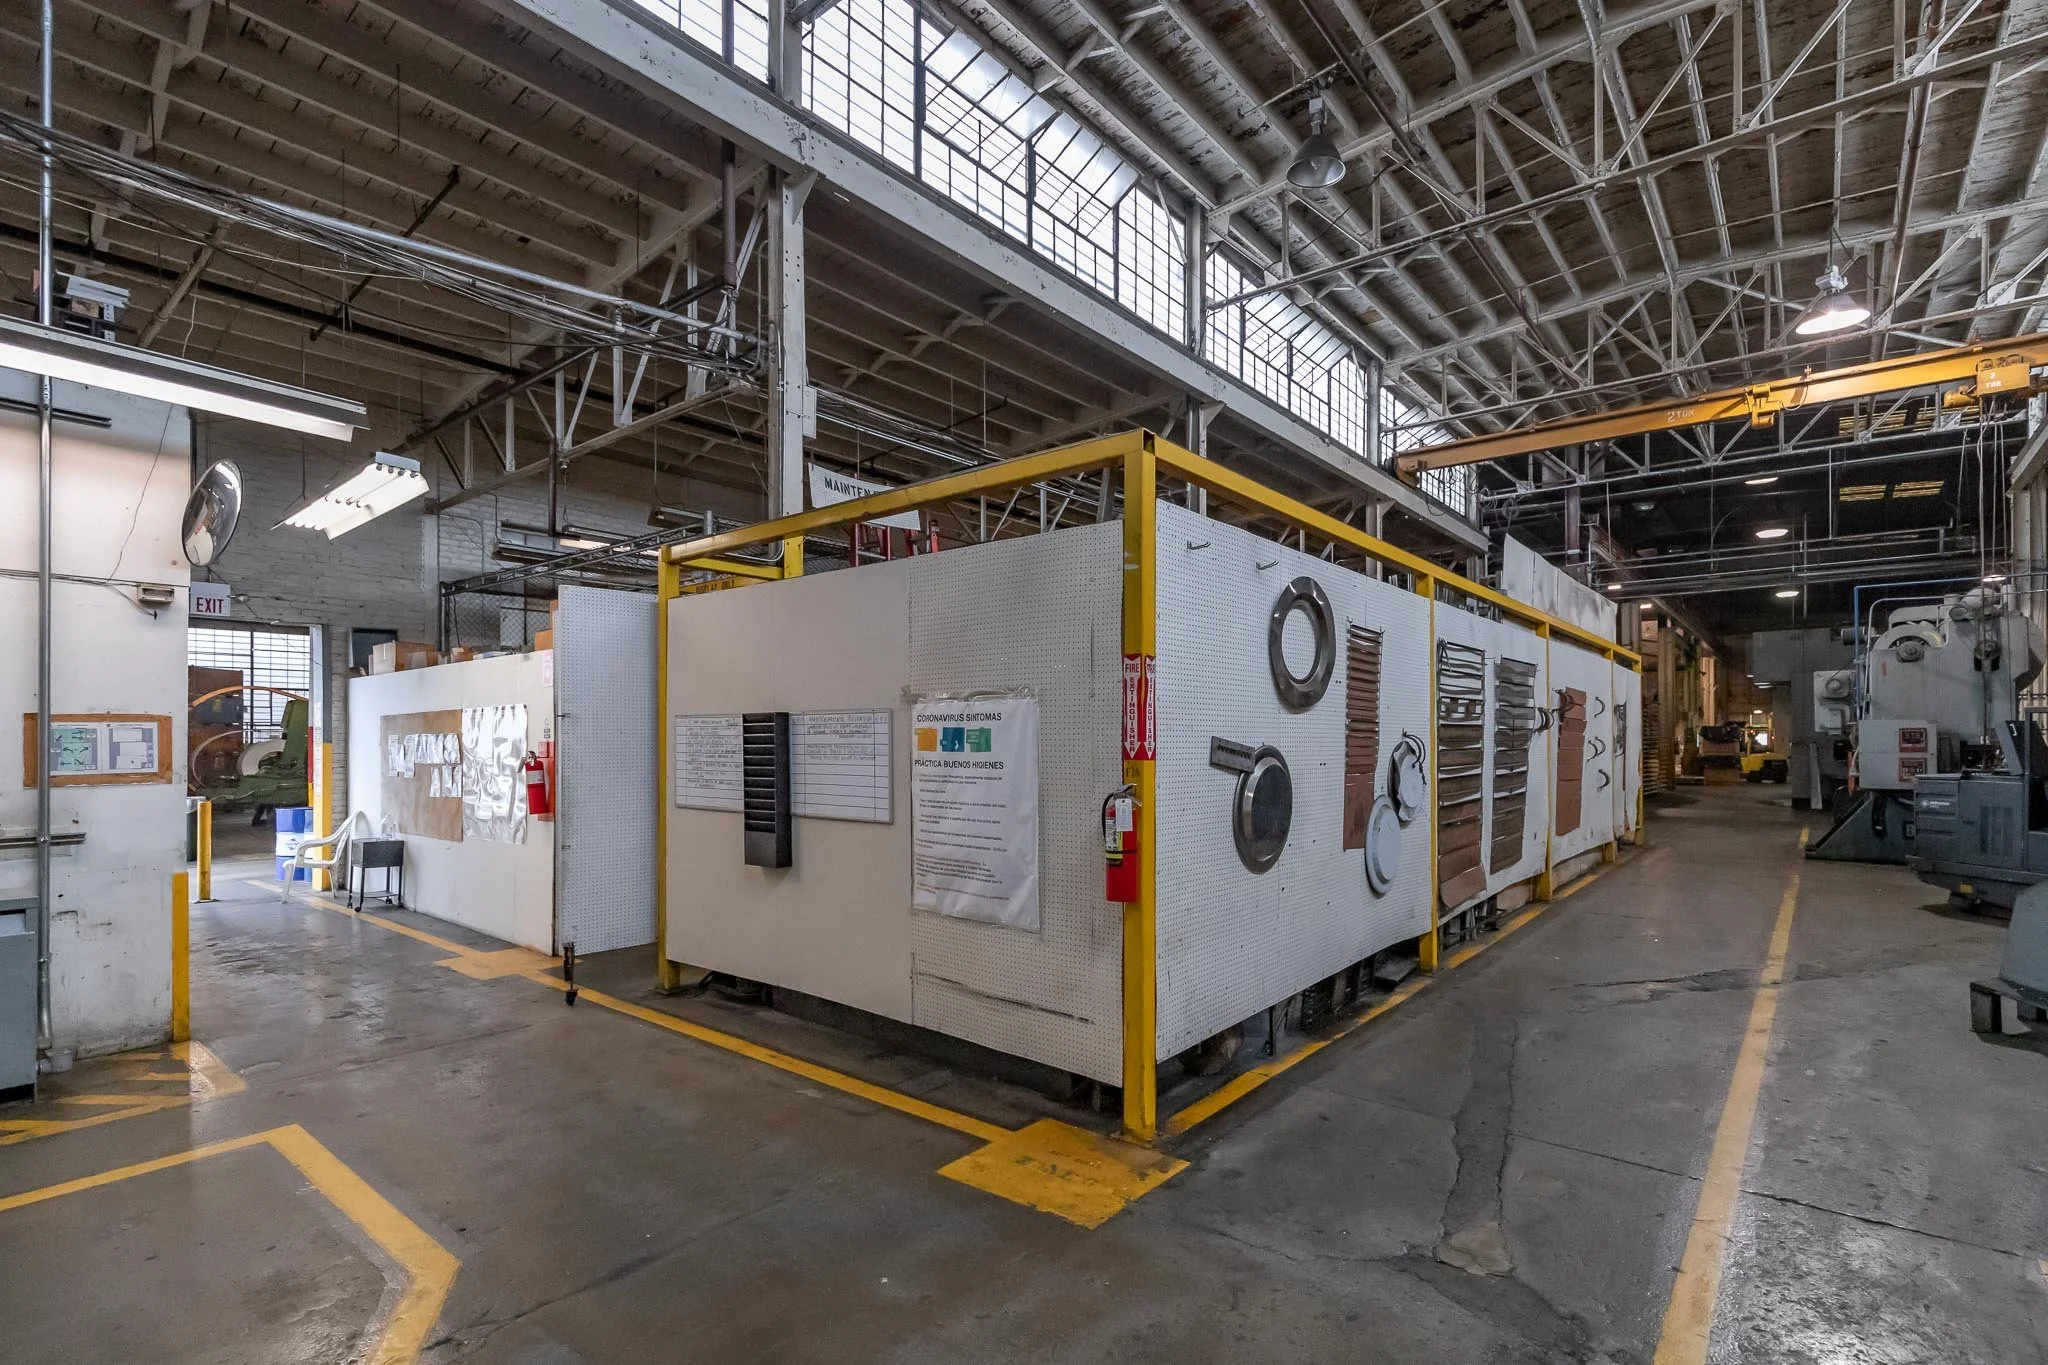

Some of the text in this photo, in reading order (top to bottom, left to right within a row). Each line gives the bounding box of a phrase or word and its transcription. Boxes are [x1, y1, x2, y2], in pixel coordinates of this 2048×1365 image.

[1666, 408, 1695, 423] 2 TON
[824, 476, 880, 497] MAINTEN
[196, 597, 224, 614] EXIT
[1125, 663, 1140, 674] FIRE
[916, 714, 965, 723] CORONAVIRUS
[1128, 677, 1136, 752] EXTINGUISHER
[943, 760, 971, 769] BUENOS
[971, 761, 1004, 770] HIGIENES
